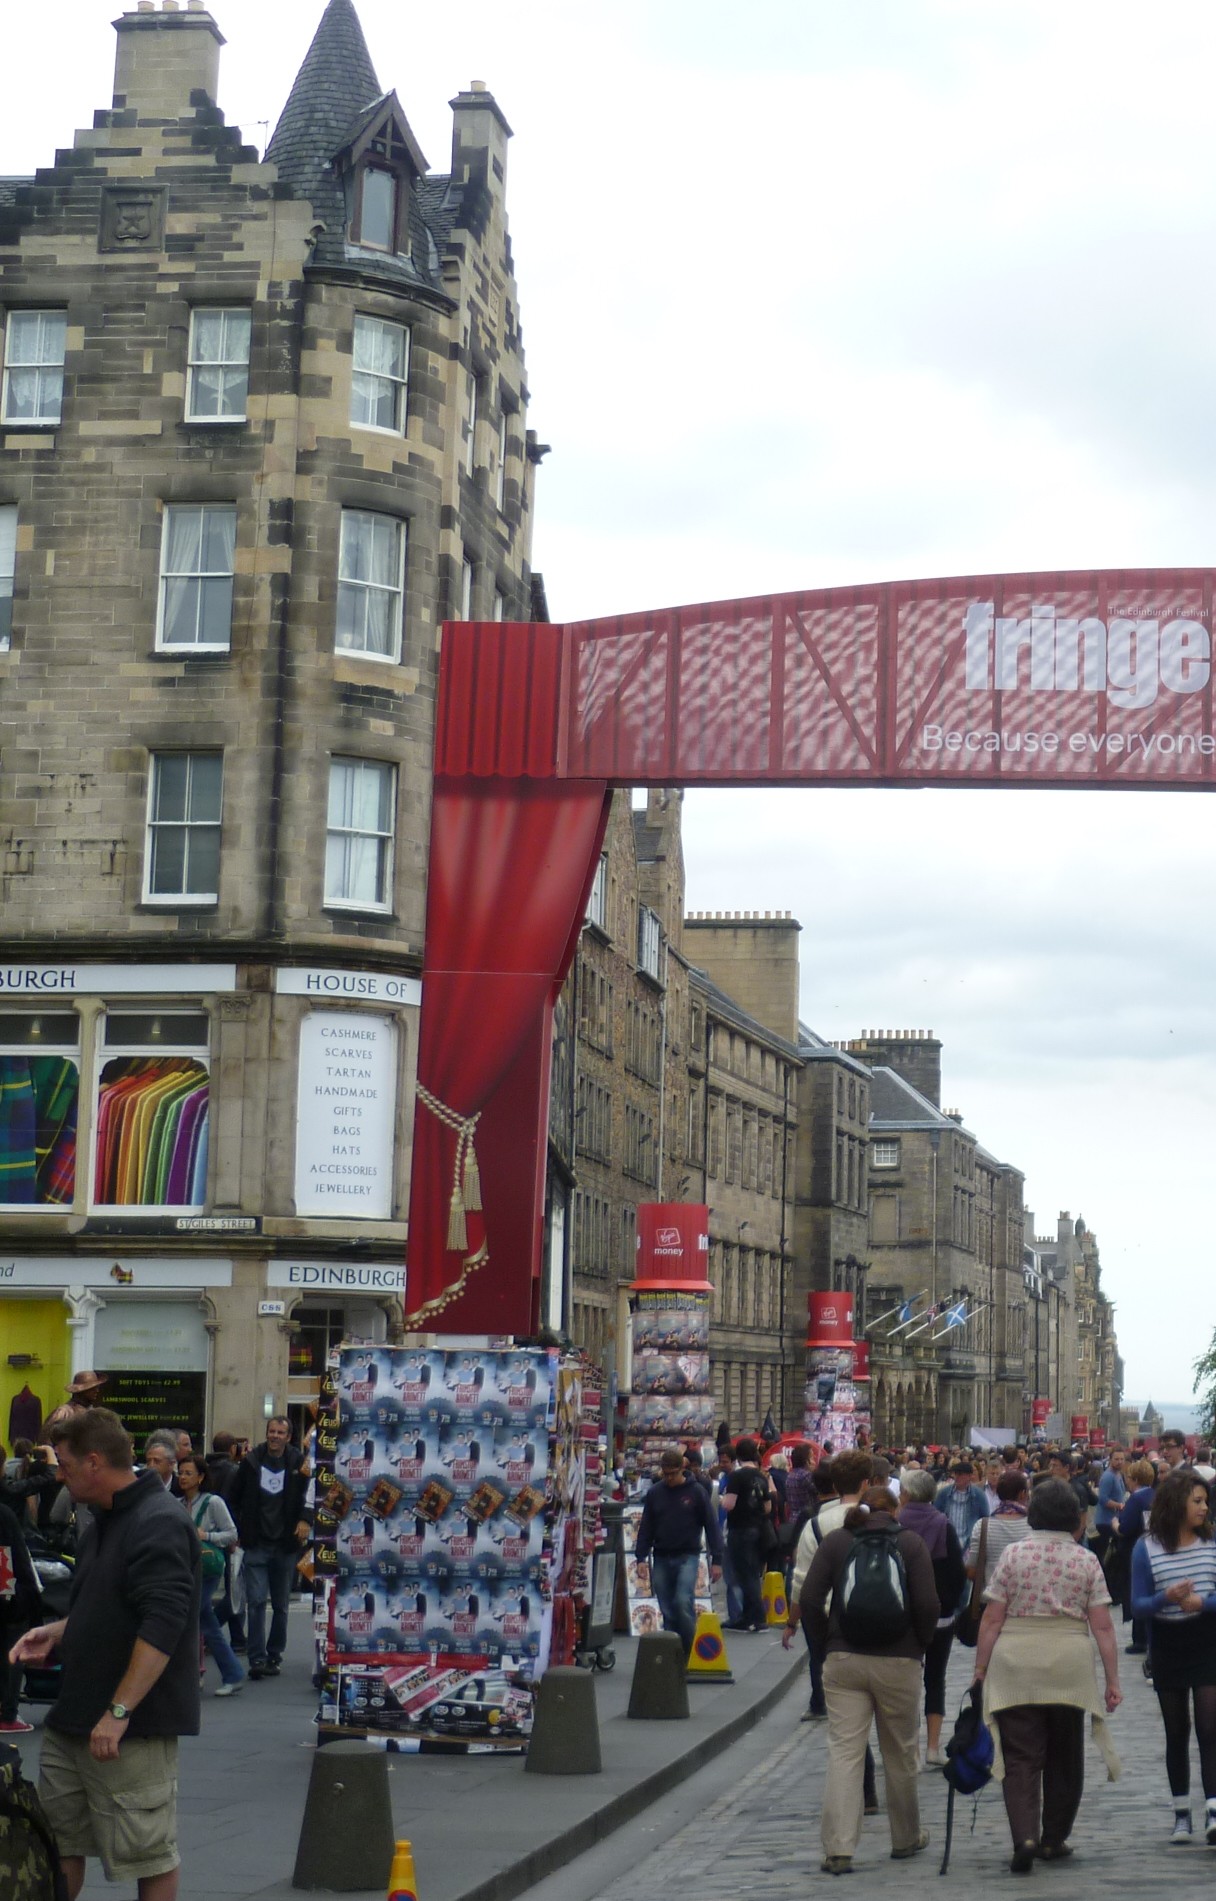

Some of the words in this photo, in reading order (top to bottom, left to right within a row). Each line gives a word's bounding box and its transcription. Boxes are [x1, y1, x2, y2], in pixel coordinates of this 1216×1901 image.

[1108, 606, 1124, 615] The
[1128, 607, 1173, 617] Edinburgh
[1176, 608, 1209, 617] Festival
[962, 602, 1211, 709] fringe
[922, 724, 1059, 752] Because
[1069, 731, 1215, 759] everyone
[0, 970, 76, 989] URGH
[306, 974, 378, 994] HOUSE
[385, 980, 408, 998] OF
[321, 1028, 377, 1041] CASHMERE
[325, 1047, 373, 1060] SCARVES
[326, 1066, 372, 1078] TARTAN
[315, 1085, 378, 1099] HANDMADE
[333, 1106, 362, 1117] GIFTS
[333, 1126, 361, 1136] BAGS
[332, 1145, 361, 1155] HATS
[310, 1164, 377, 1176] ACCESSORIES
[315, 1183, 372, 1195] JEWELLERY
[221, 1219, 254, 1228] STREET
[654, 1247, 684, 1256] money
[289, 1266, 406, 1287] EDINBURGH
